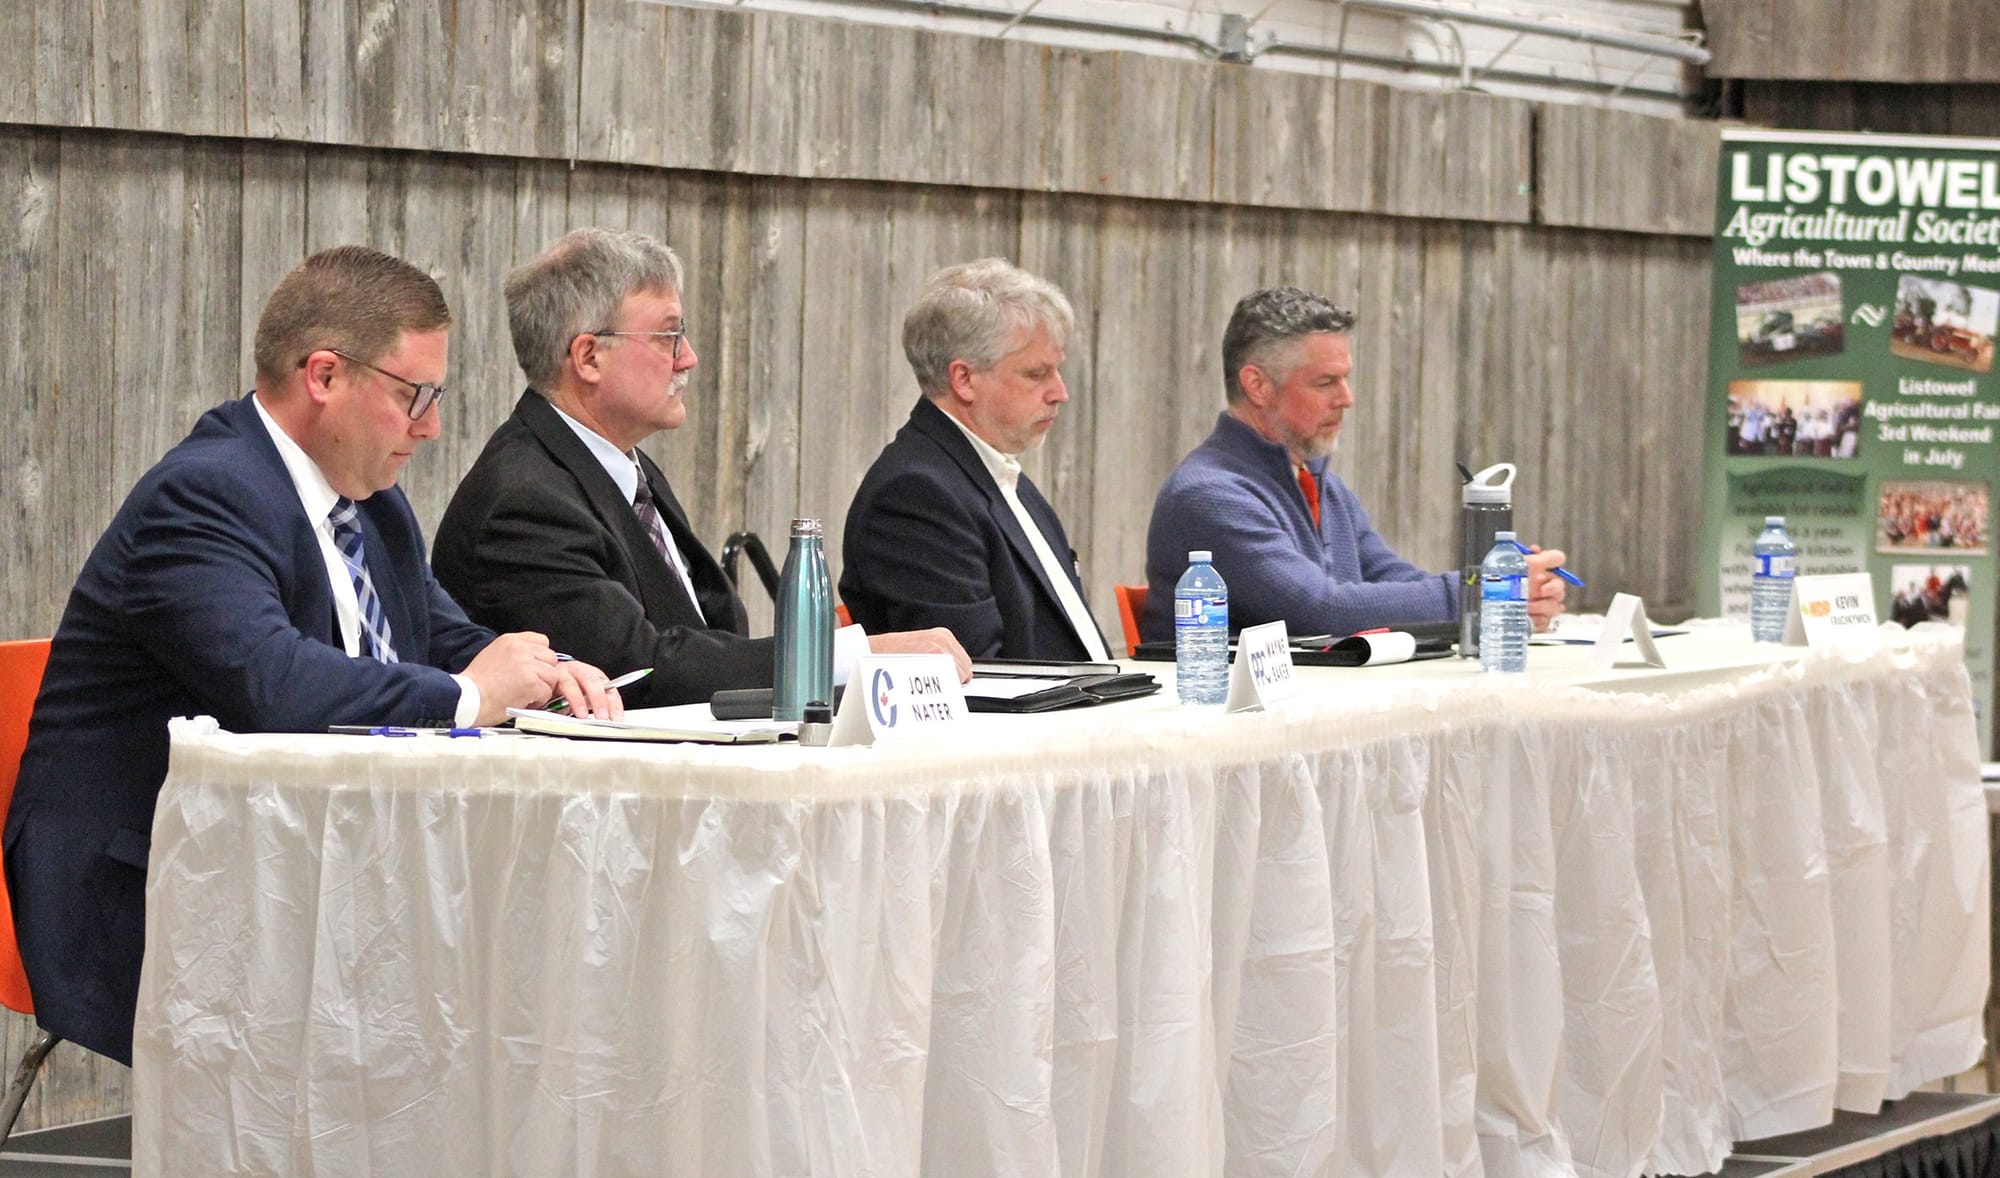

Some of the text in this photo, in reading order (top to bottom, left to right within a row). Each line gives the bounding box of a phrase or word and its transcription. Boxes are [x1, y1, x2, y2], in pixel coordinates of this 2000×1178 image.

[1730, 151, 2000, 210] LISTOWEL
[1722, 205, 2000, 252] Agricultural Societ
[1732, 247, 1791, 267] Where
[1793, 247, 1821, 268] the
[1824, 249, 1874, 269] Town
[1875, 252, 1889, 270] &
[1891, 253, 1960, 276] Country
[1898, 377, 1976, 397] Listowel
[1863, 400, 1969, 421] Agricultural
[1877, 422, 1993, 444] 3rd Weekend
[1903, 448, 1967, 470] in July
[908, 676, 942, 695] JOHN
[911, 703, 953, 722] NATER
